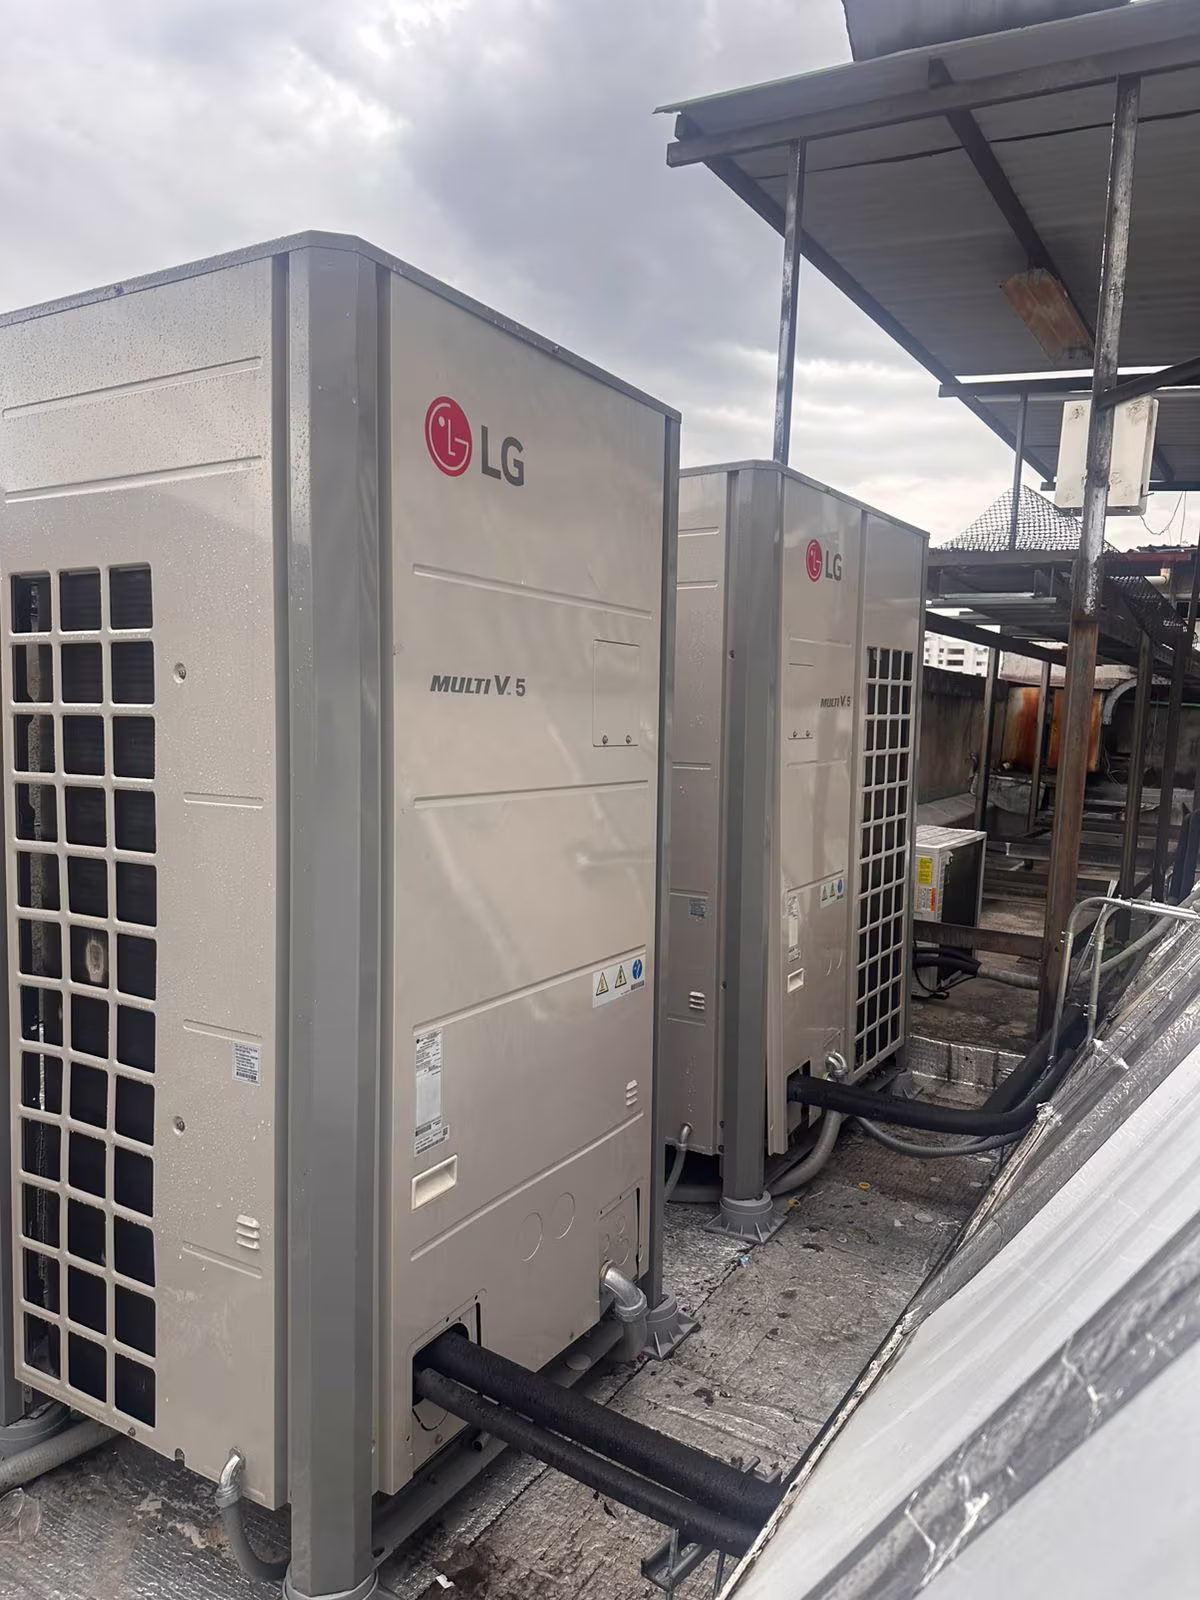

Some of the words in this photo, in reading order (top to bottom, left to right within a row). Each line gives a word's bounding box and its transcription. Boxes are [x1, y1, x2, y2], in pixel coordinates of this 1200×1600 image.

[481, 424, 524, 487] LG
[825, 550, 842, 581] LG
[430, 675, 491, 694] MULTI
[515, 678, 526, 697] 5
[820, 697, 840, 708] MULTI
